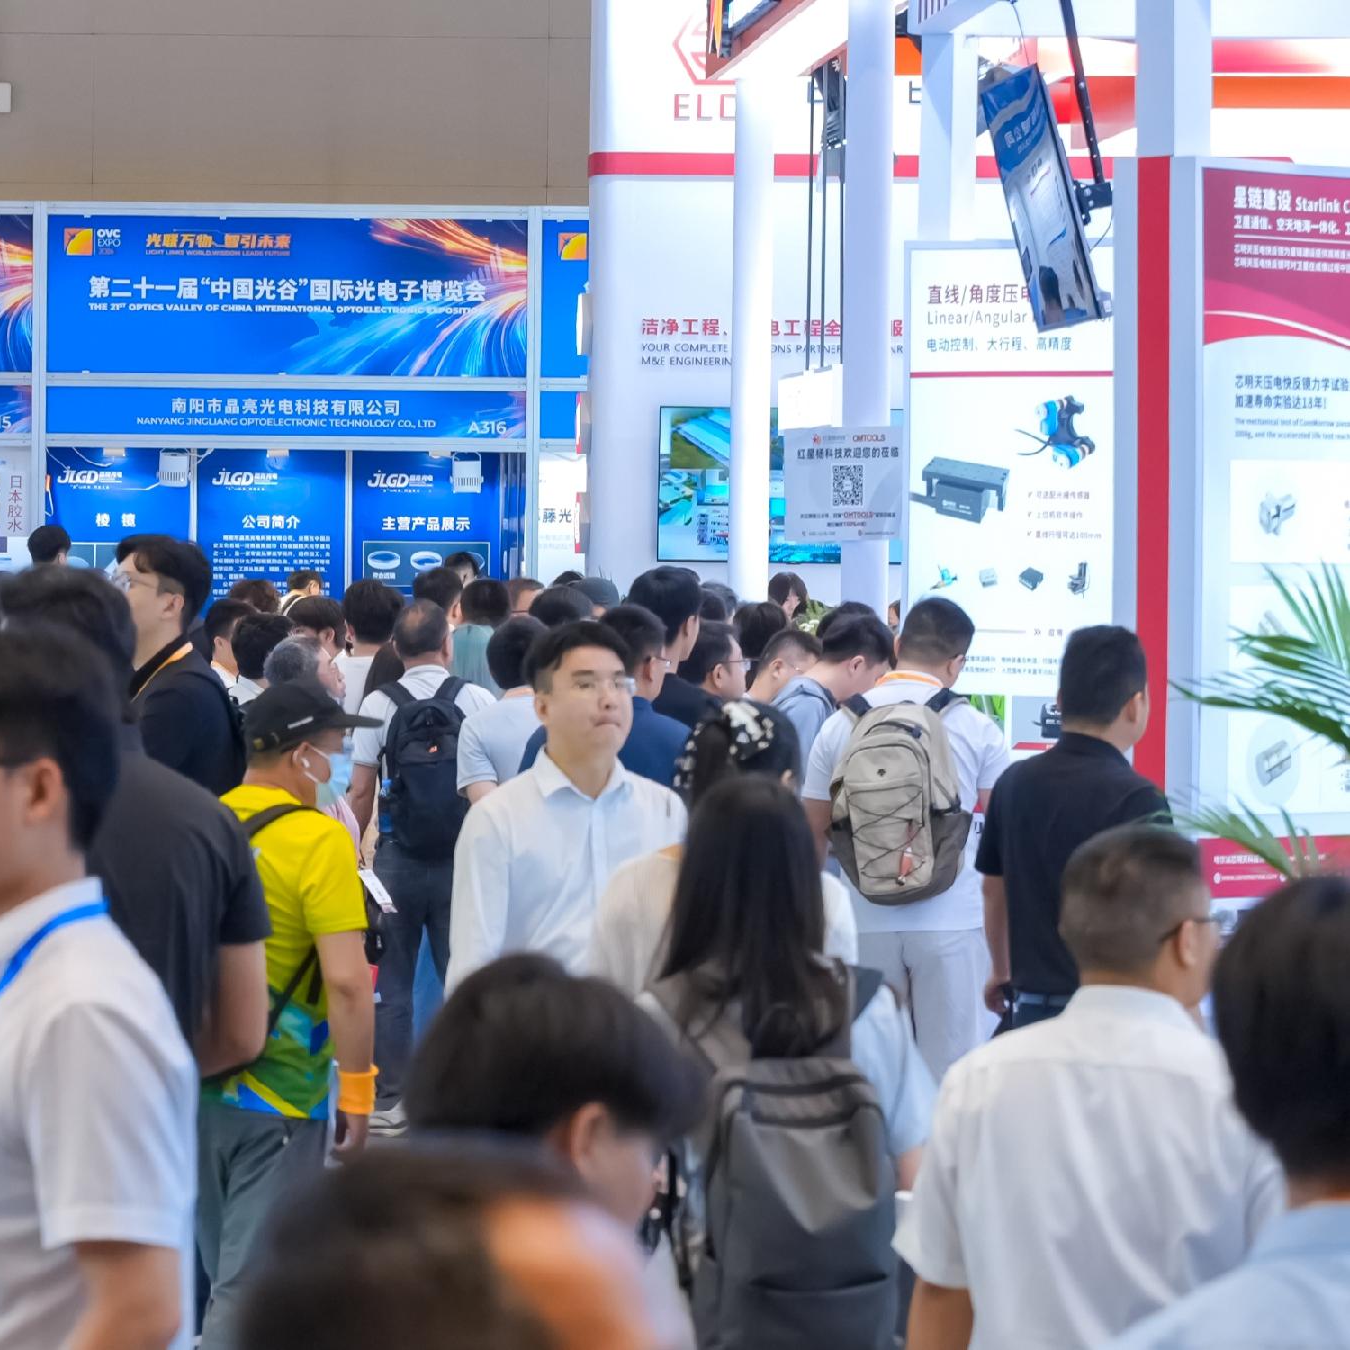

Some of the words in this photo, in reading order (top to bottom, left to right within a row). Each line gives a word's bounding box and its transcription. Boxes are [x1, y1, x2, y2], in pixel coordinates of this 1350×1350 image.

[1295, 196, 1341, 213] Starlink
[96, 229, 121, 238] OVC
[97, 238, 121, 248] EXPO
[89, 276, 486, 302] 第二十一届“中国光谷”国际光电子博览会
[88, 303, 108, 311] THE
[128, 303, 164, 311] OPTICS
[165, 303, 203, 312] VALLEY
[206, 303, 220, 312] OF
[221, 304, 252, 312] CHINA
[255, 304, 334, 313] INTERNATIONAL
[927, 310, 1027, 328] Linear/Angular
[641, 343, 670, 353] YOUR
[674, 343, 728, 353] COMPLETE
[641, 356, 665, 366] M&E
[670, 356, 732, 366] ENGINEERIN
[171, 397, 400, 416] 南阳市晶亮光电科技有限公司
[136, 417, 185, 426] NANYANG
[186, 417, 238, 427] JINGLIANG
[239, 417, 328, 428] OPTOELECTRONIC
[329, 418, 395, 428] TECHNOLOGY
[468, 421, 507, 434] A316
[212, 467, 254, 486] JLGD
[367, 470, 409, 488] JLGD
[7, 475, 23, 533] 日本胶水
[242, 515, 301, 529] 公司简介
[381, 516, 471, 532] 主营产品展示
